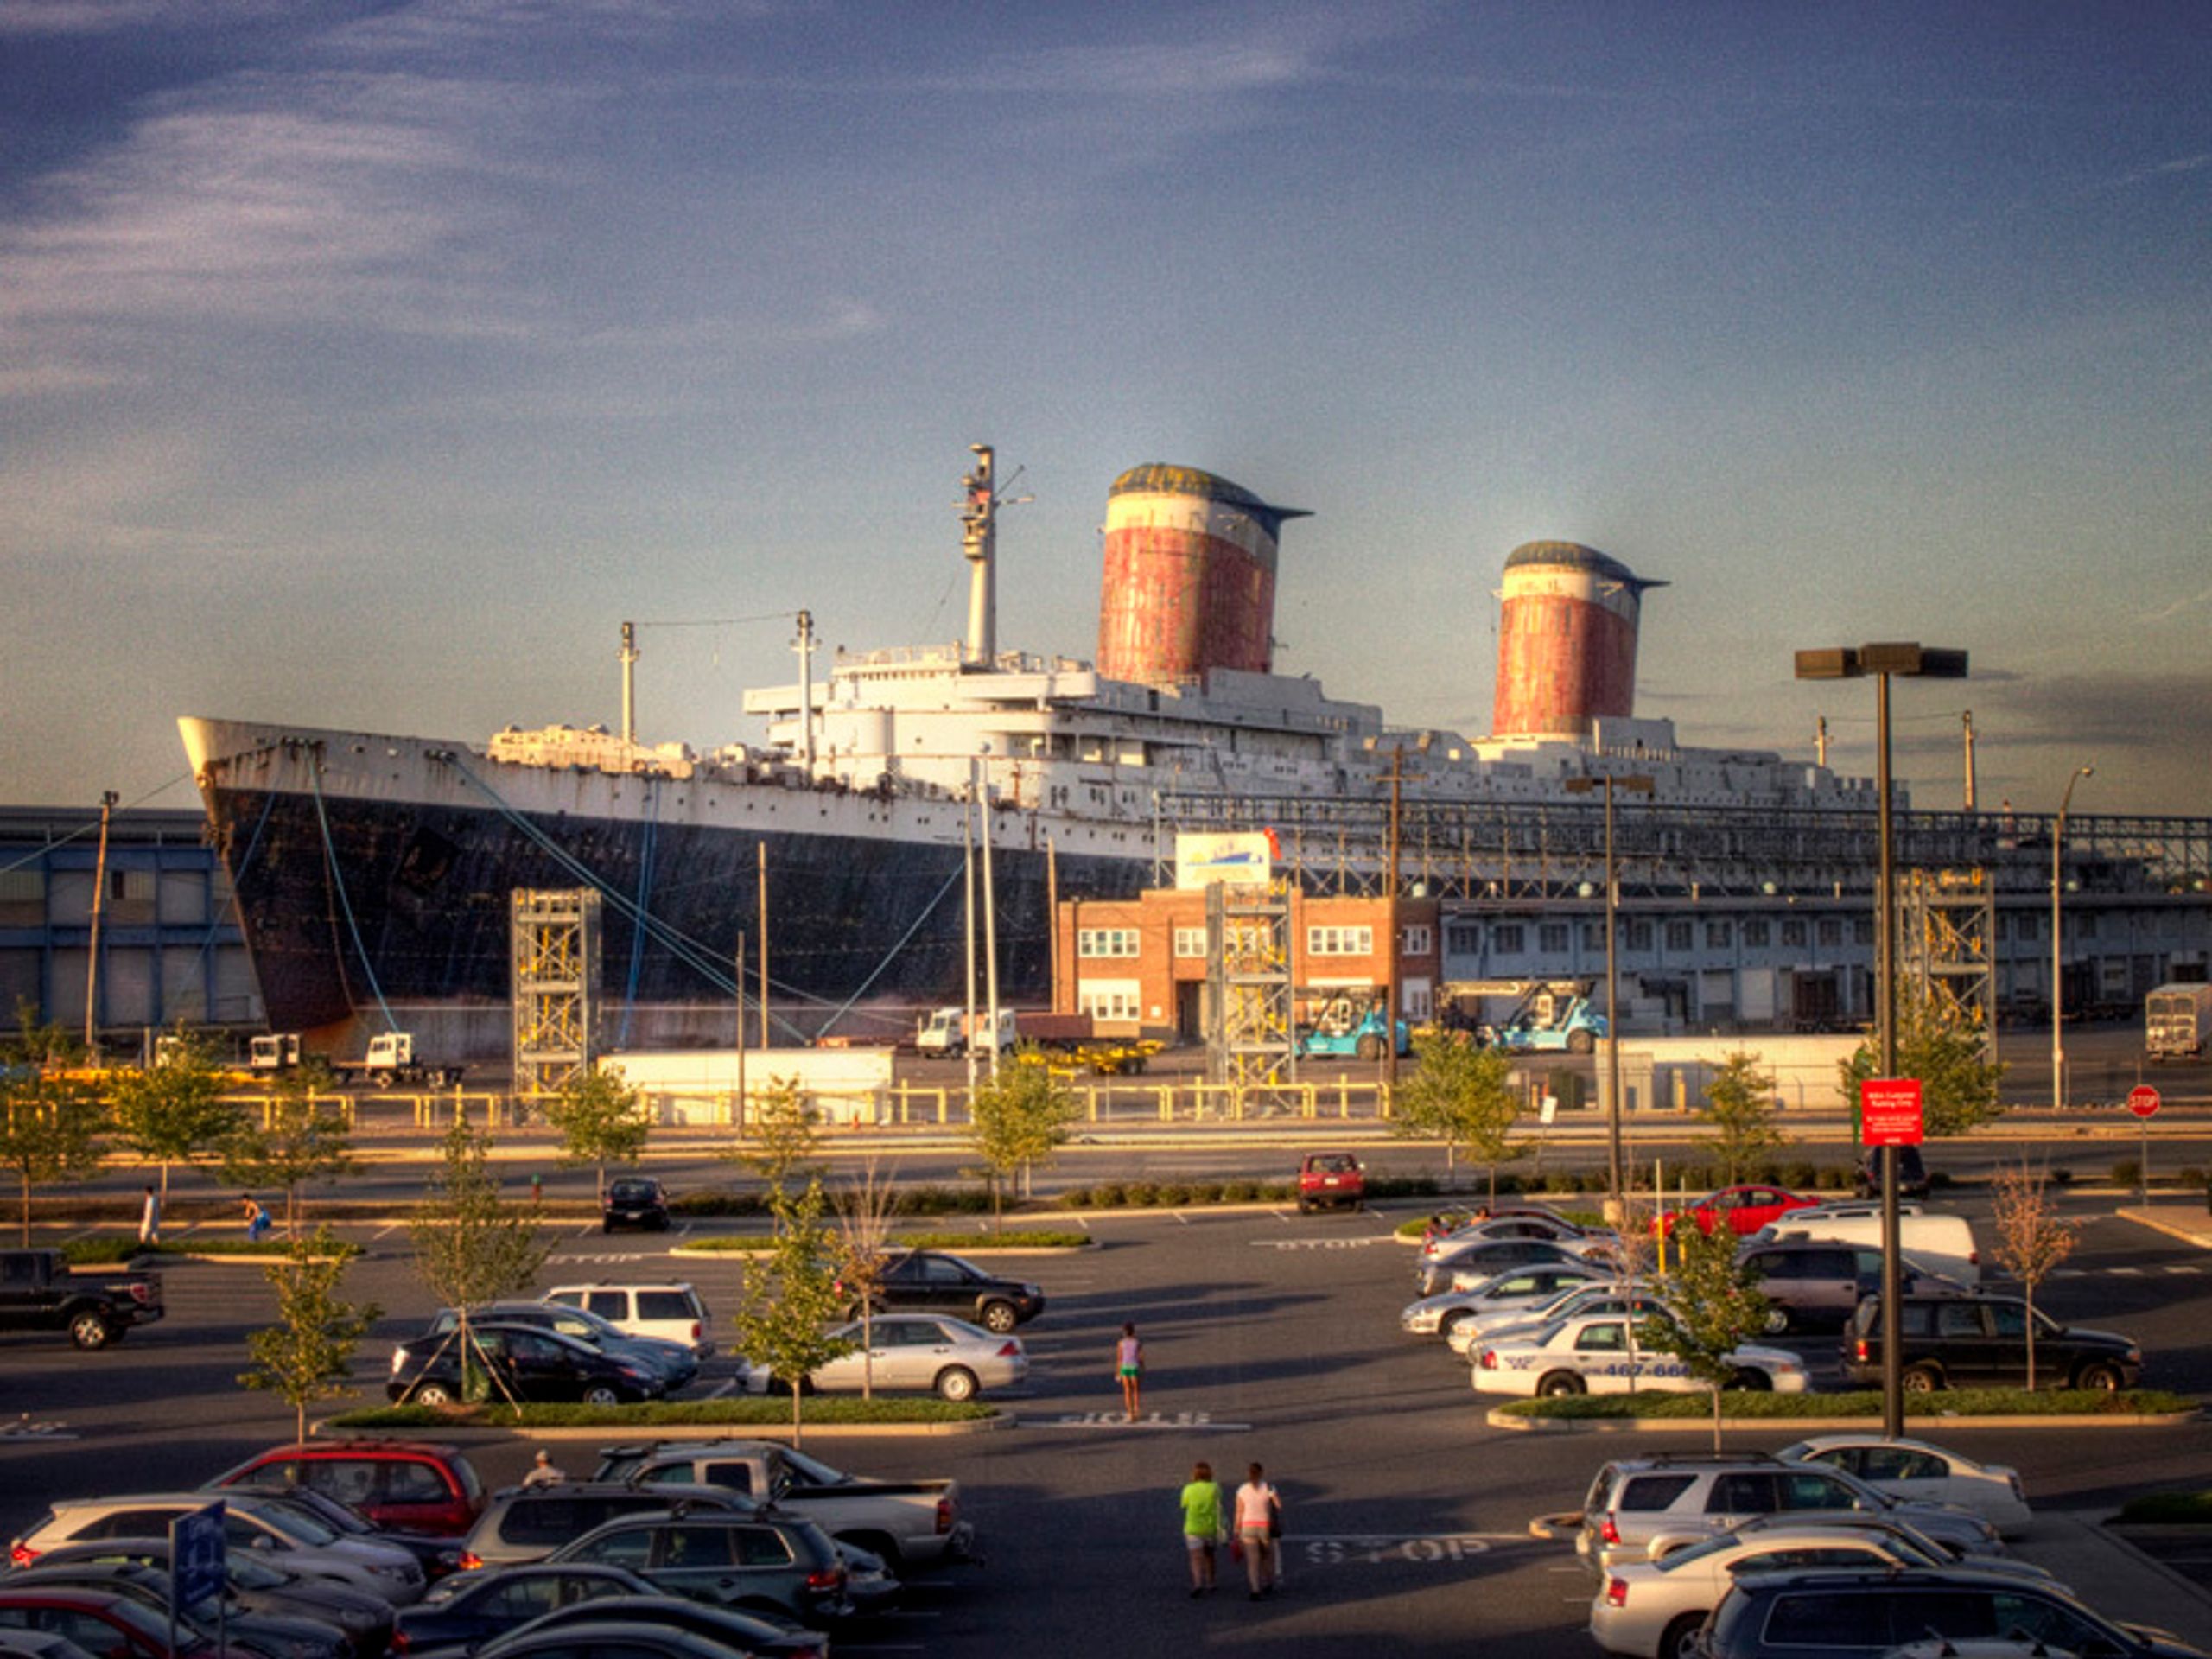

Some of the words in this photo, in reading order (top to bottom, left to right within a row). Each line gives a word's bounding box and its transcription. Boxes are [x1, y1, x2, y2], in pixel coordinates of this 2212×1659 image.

[2130, 1095, 2157, 1107] STOP
[1275, 1239, 1371, 1250] STOP
[1305, 1538, 1490, 1564] STOP
